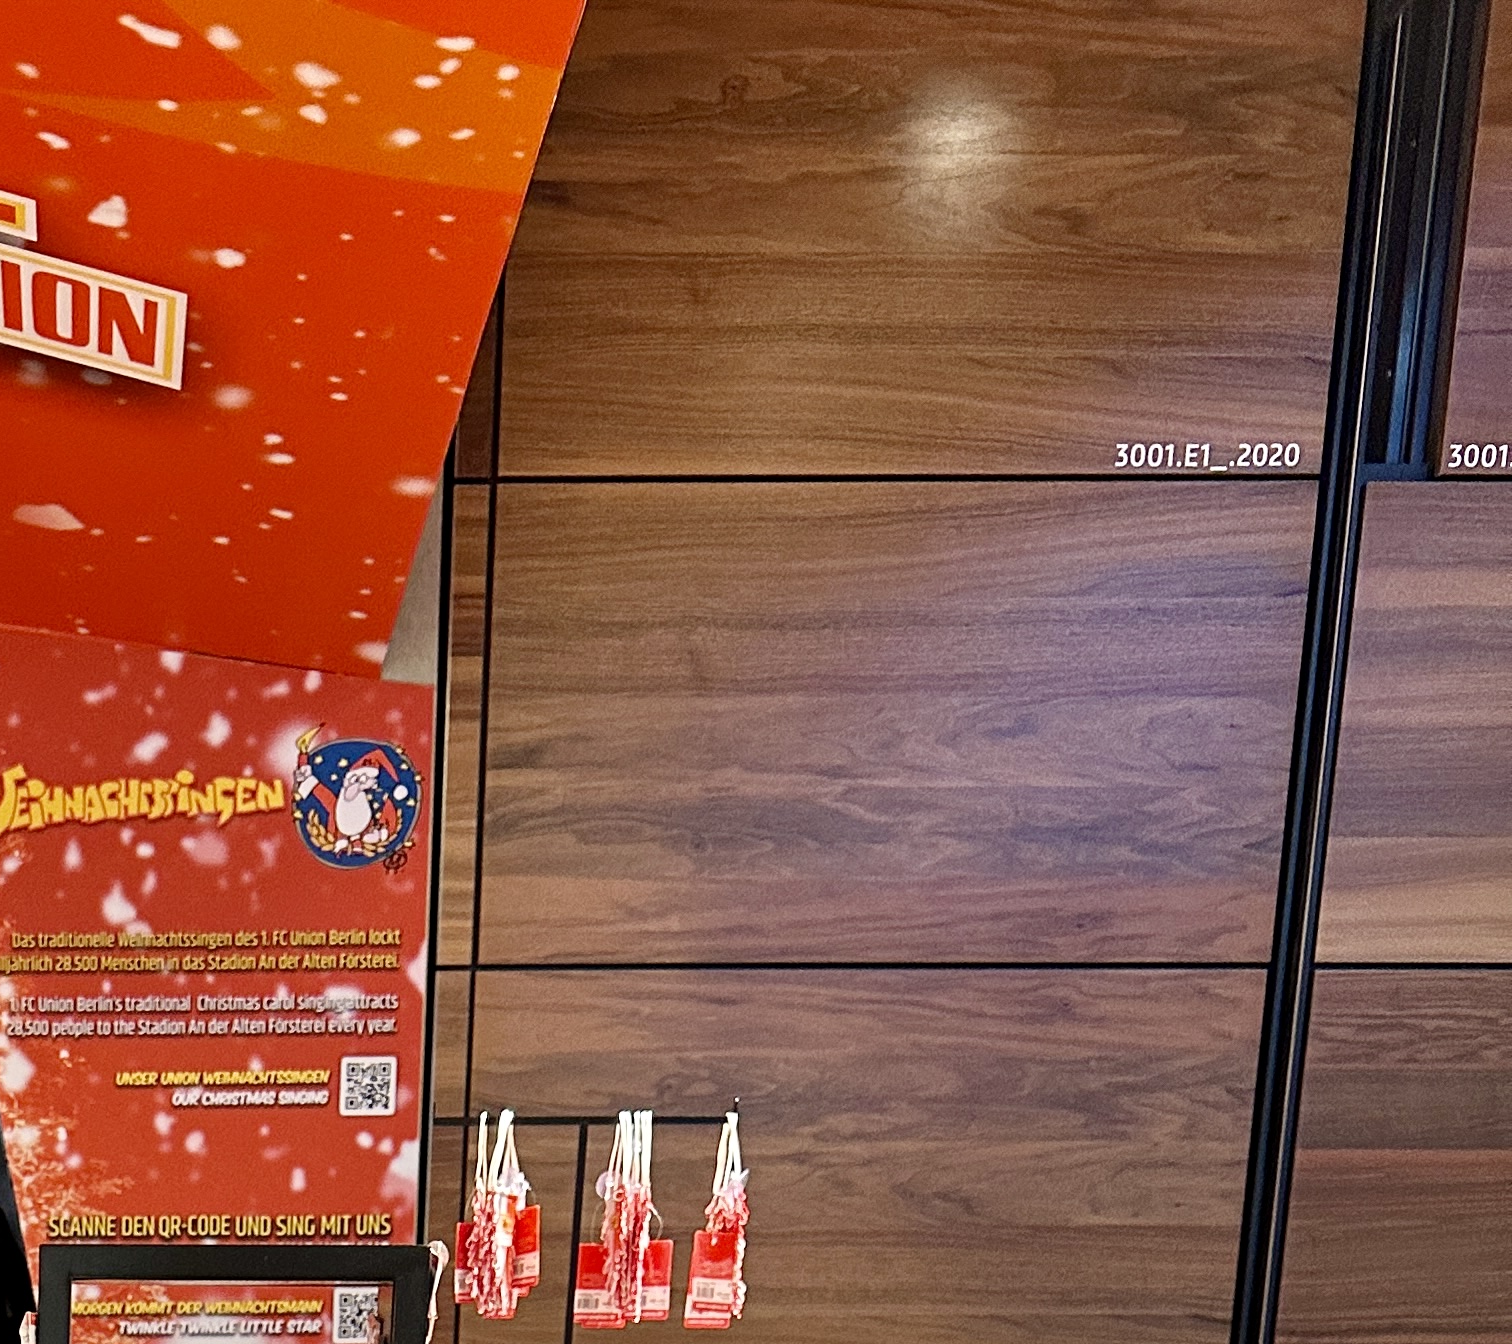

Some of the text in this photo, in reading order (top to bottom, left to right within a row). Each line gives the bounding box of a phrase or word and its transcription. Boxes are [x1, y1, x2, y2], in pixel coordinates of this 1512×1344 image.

[1115, 442, 1301, 471] 3001.E1_.2020
[12, 930, 400, 950] Das traditionelle Weihnachtssingen des FC Union Berlin lockt
[55, 956, 98, 971] 28.500
[101, 955, 164, 971] Menschen
[166, 955, 179, 970] in
[182, 955, 204, 970] das
[207, 954, 256, 970] Stadion
[259, 954, 276, 970] An
[279, 954, 300, 969] der
[303, 954, 336, 969] Alten
[21, 994, 398, 1014] FC Union Berlin's traditional Christmas carol singing attracts
[51, 1020, 94, 1038] people
[97, 1020, 110, 1035] to
[113, 1019, 134, 1035] the
[136, 1019, 186, 1035] Stadion
[188, 1019, 206, 1034] An
[208, 1019, 230, 1034] der
[232, 1018, 265, 1034] Alten
[268, 1018, 325, 1034] Försterei
[328, 1018, 365, 1036] every
[116, 1070, 330, 1086] UNSER UNION WEIHNACHTSSINGEN
[171, 1090, 329, 1106] OUR CHRISTMAS SINGING
[48, 1214, 391, 1238] SCANNE DEN QR-CODE UND SING MIT UNS
[72, 1301, 323, 1315] MORGEN KOMMT DER WEIHNACHTSMANN
[119, 1320, 323, 1335] TWINKLE TWINKLE LITTLE STAR
